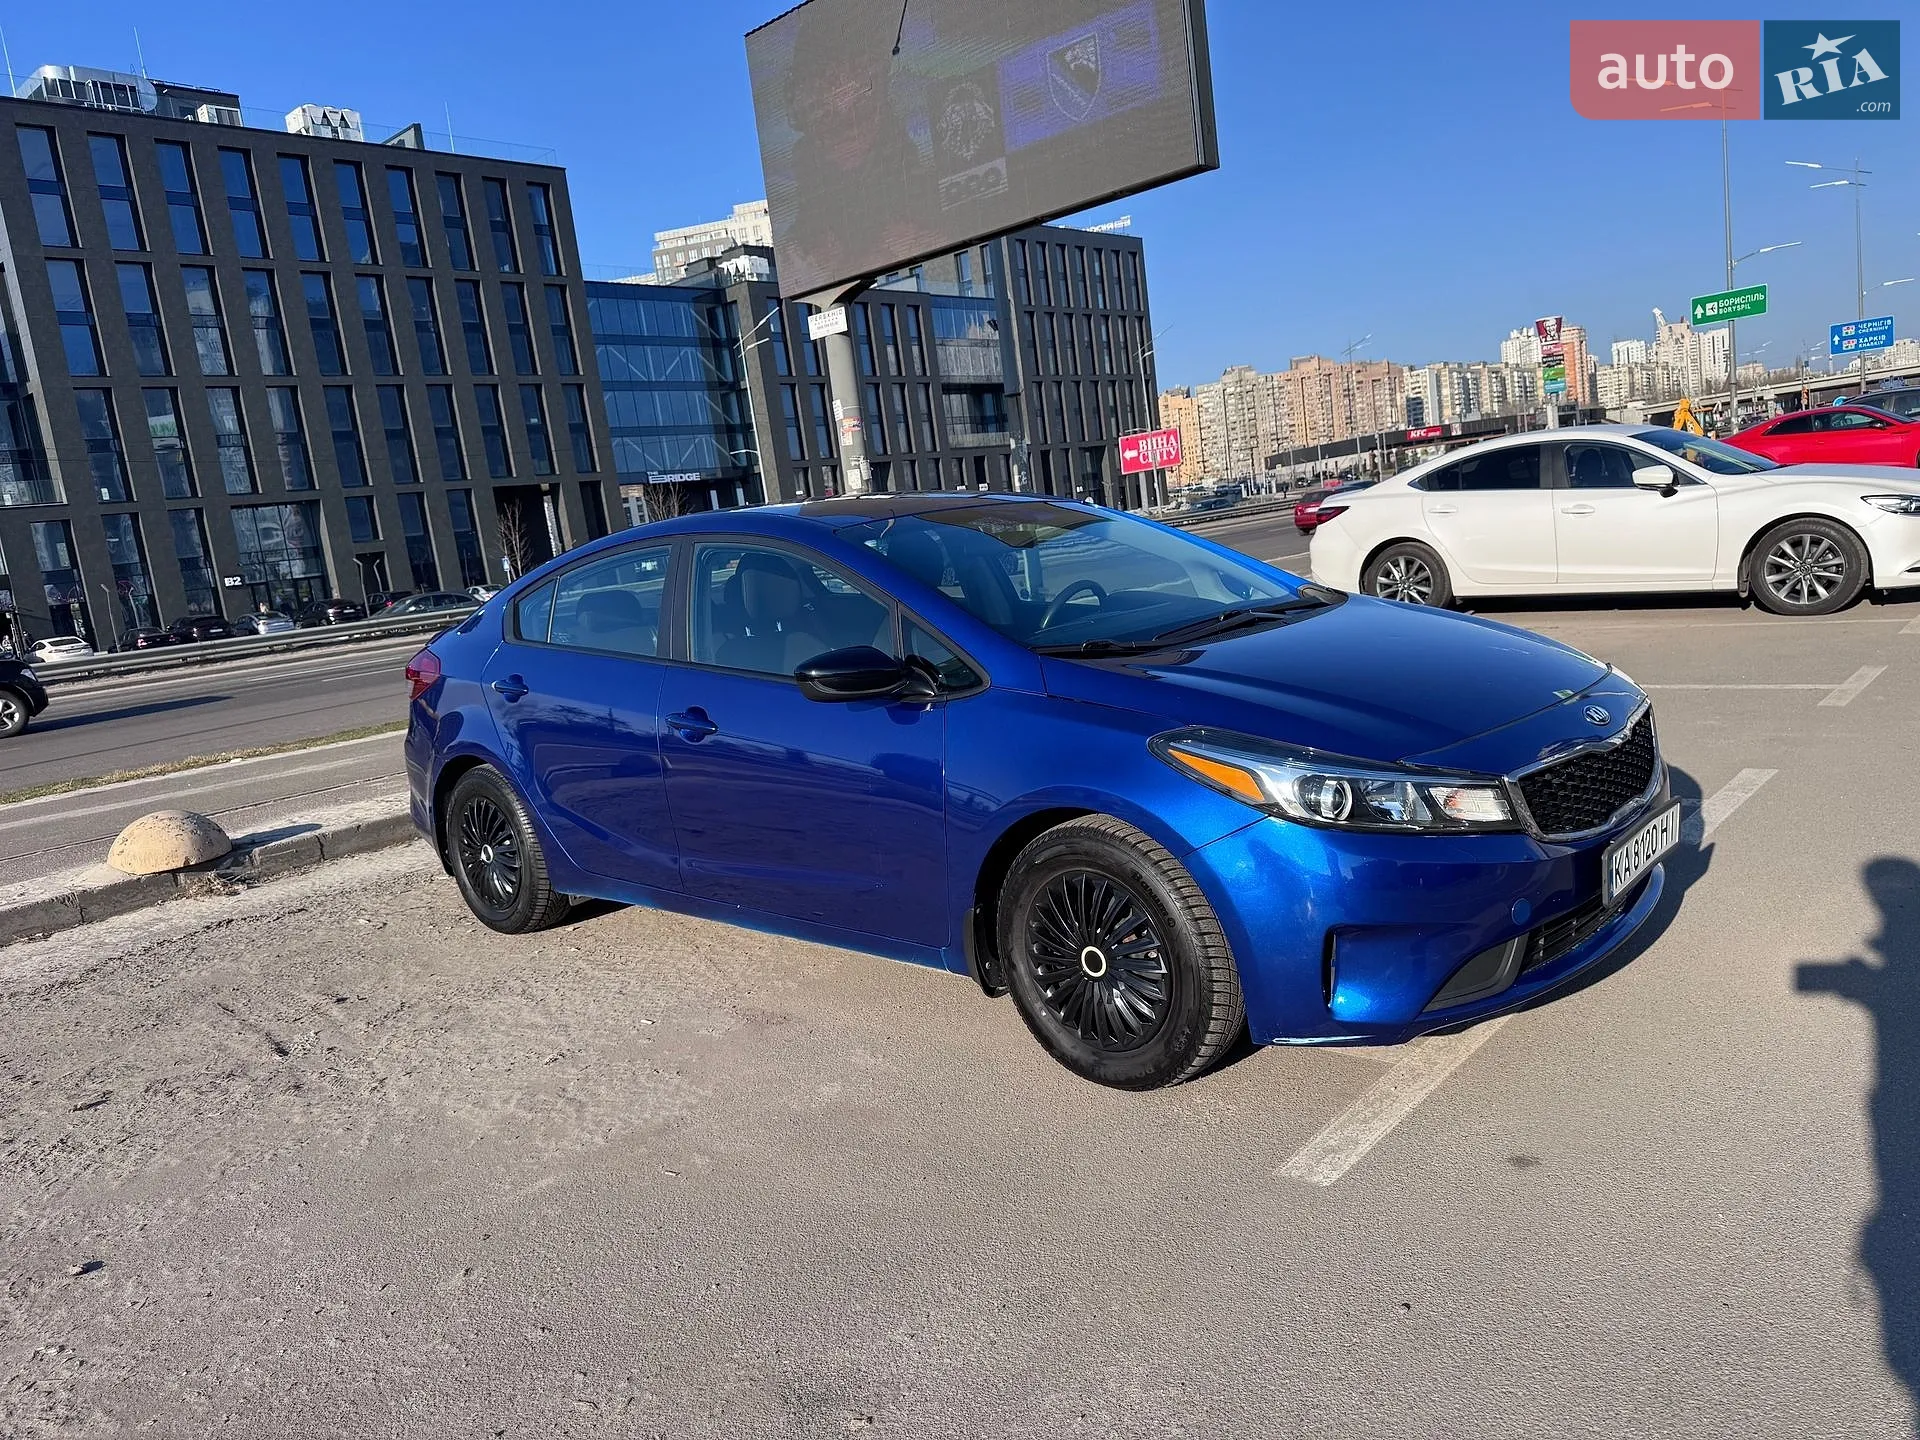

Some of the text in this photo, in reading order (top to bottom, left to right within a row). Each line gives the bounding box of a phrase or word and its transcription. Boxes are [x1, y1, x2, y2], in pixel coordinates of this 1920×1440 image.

[1718, 292, 1765, 308] БОРИСПІЛЬ
[1718, 303, 1751, 315] BORYSPIL
[1858, 319, 1892, 329] ЧЕРНІГІВ
[1858, 334, 1886, 344] ХАРКІВ
[1410, 429, 1427, 439] KFC
[649, 472, 701, 484] BRIDGE
[224, 576, 243, 587] B2
[1614, 811, 1675, 889] KA 8120 HI
